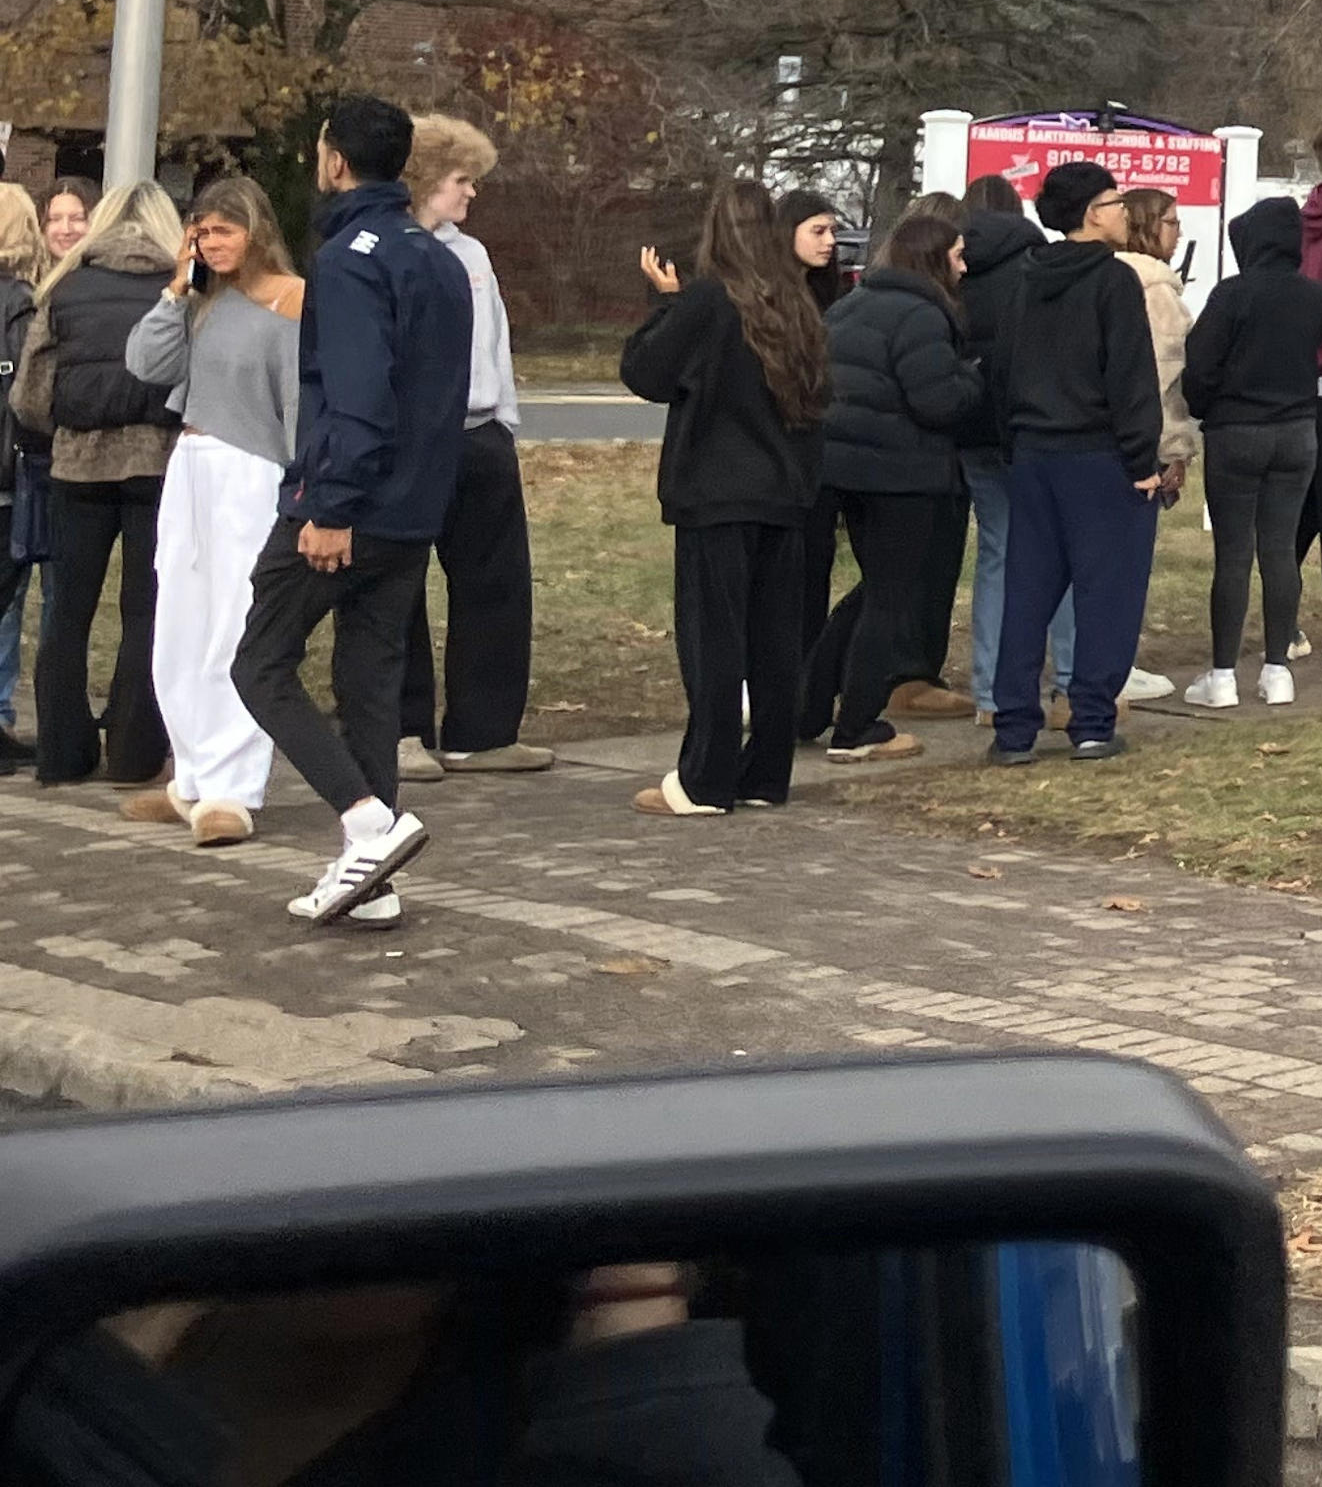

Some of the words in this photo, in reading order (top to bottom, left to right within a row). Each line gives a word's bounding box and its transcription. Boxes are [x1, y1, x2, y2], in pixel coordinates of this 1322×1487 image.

[971, 126, 1024, 143] FAMOUS
[1106, 132, 1151, 149] SCHOOL
[1167, 136, 1221, 153] STAFFING
